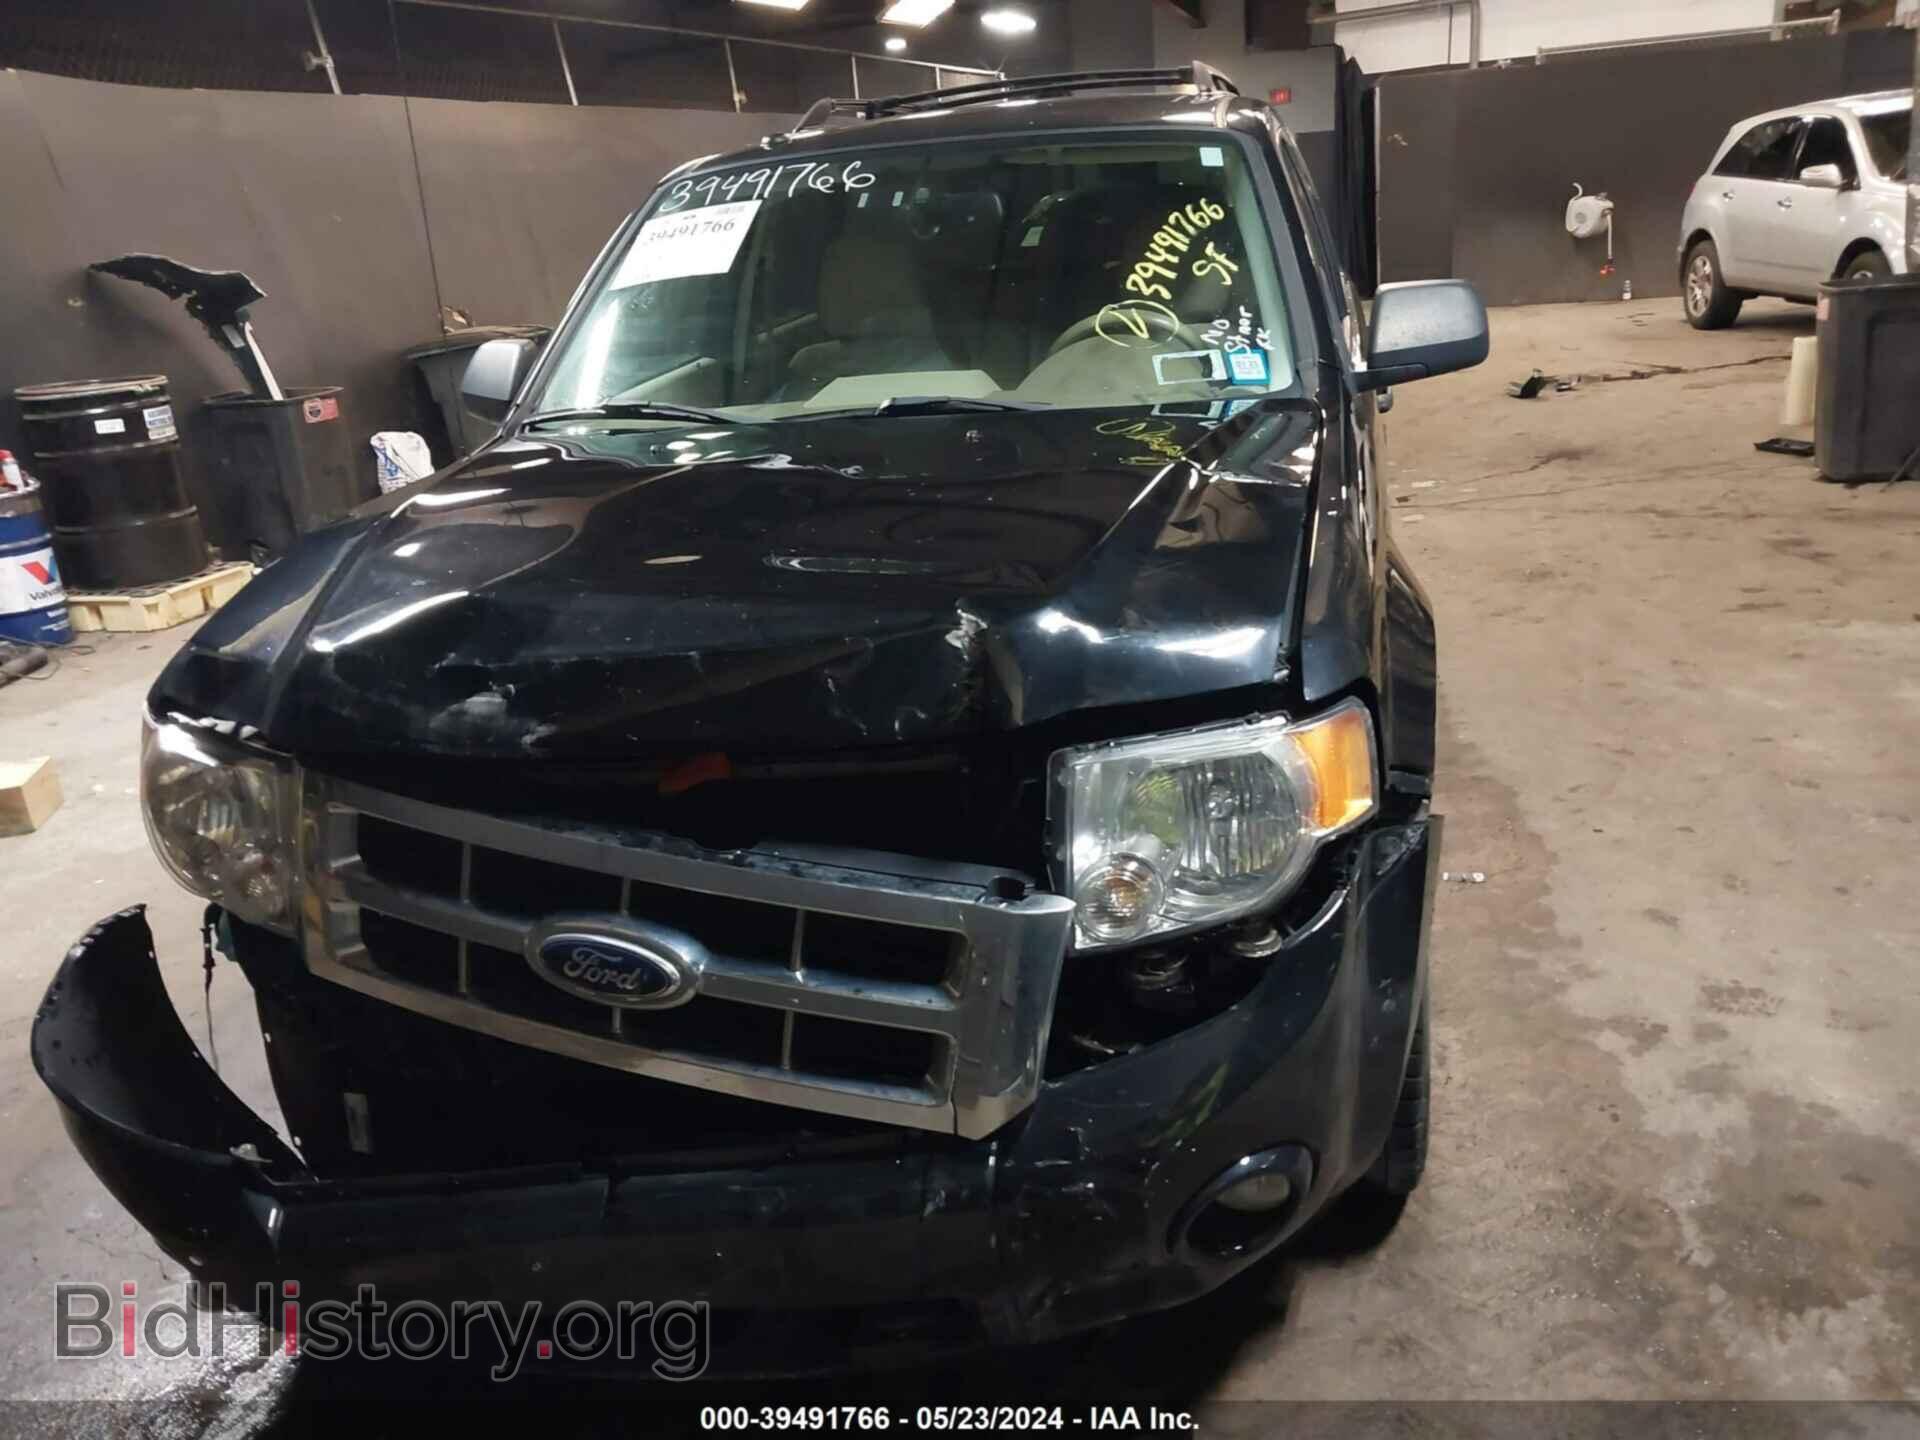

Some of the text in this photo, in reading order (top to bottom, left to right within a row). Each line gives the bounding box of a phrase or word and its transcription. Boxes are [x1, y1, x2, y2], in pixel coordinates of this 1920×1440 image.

[658, 160, 877, 212] 39491766
[1125, 197, 1224, 300] 39491766
[562, 947, 641, 990] Ford
